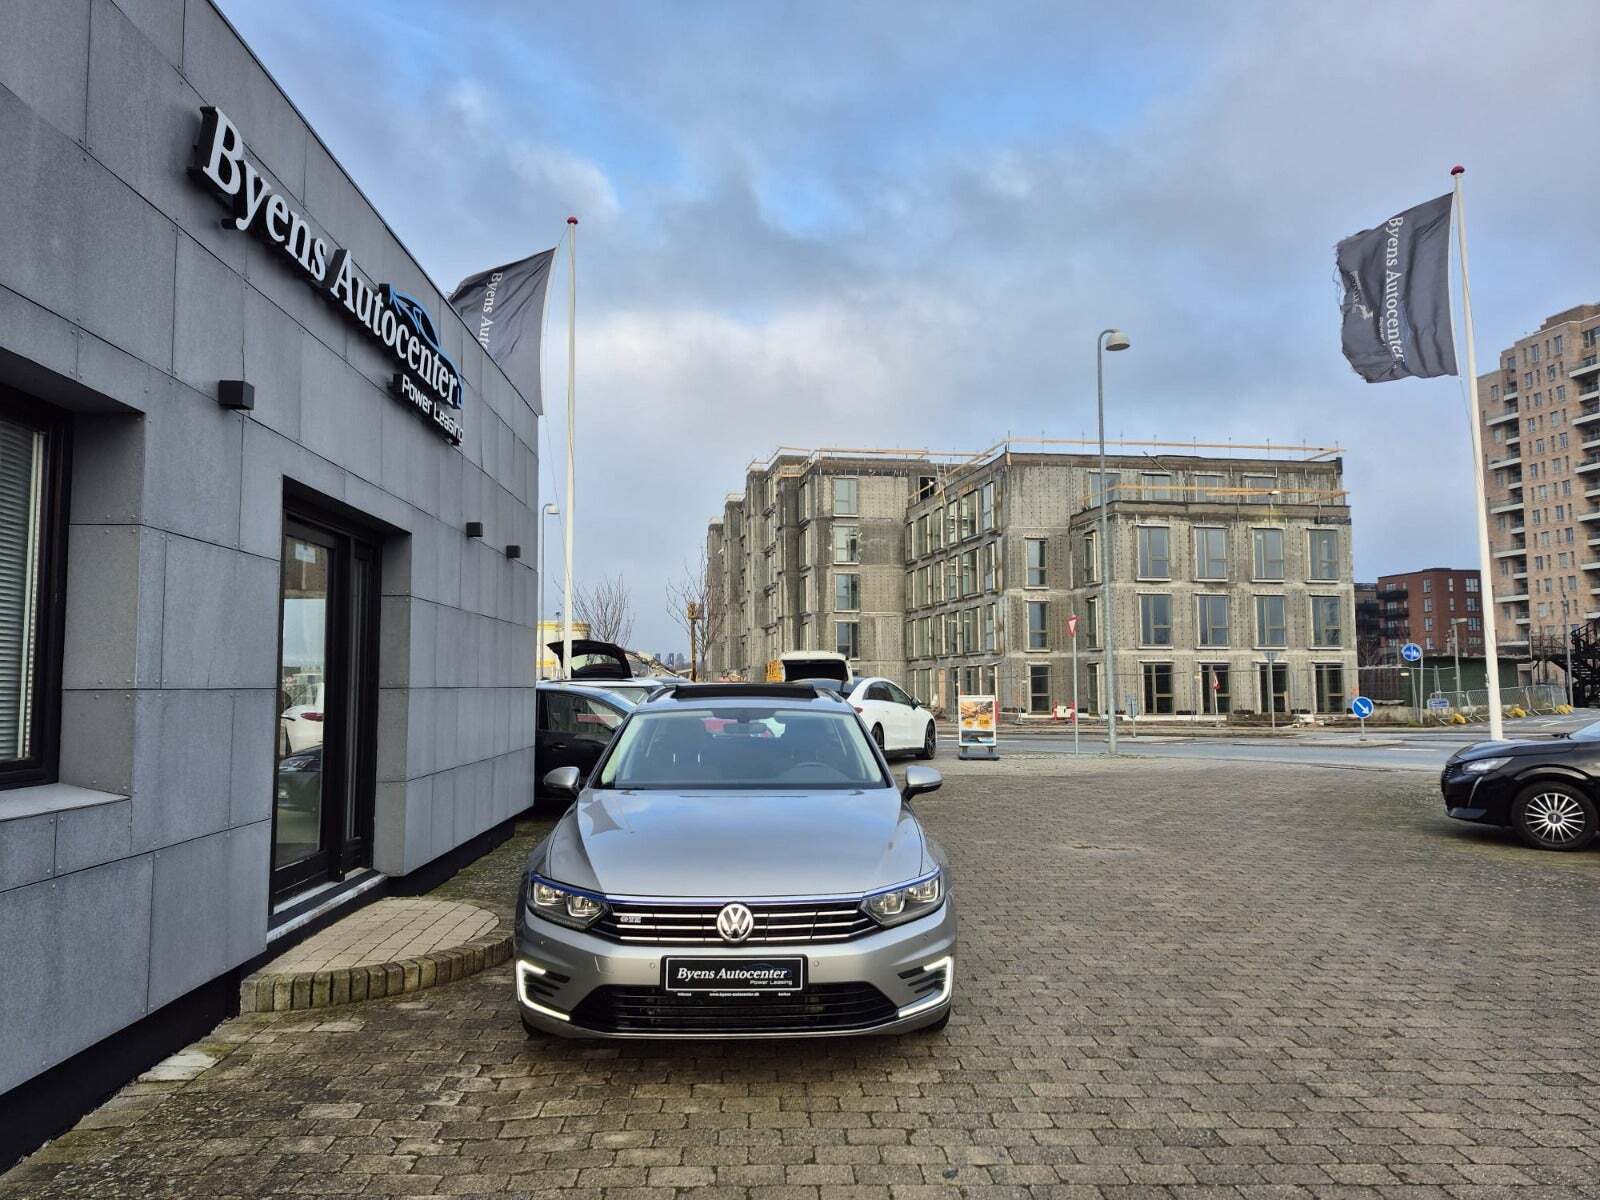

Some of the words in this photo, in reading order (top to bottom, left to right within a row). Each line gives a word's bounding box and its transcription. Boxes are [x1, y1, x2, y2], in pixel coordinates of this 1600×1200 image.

[202, 106, 328, 282] Byens
[329, 249, 459, 406] Autocenter
[1386, 216, 1403, 266] Byens
[483, 272, 503, 313] Byens
[1385, 269, 1405, 362] Autocenter
[402, 374, 432, 415] Power
[677, 967, 715, 981] Byens
[717, 967, 788, 979] Autocenter
